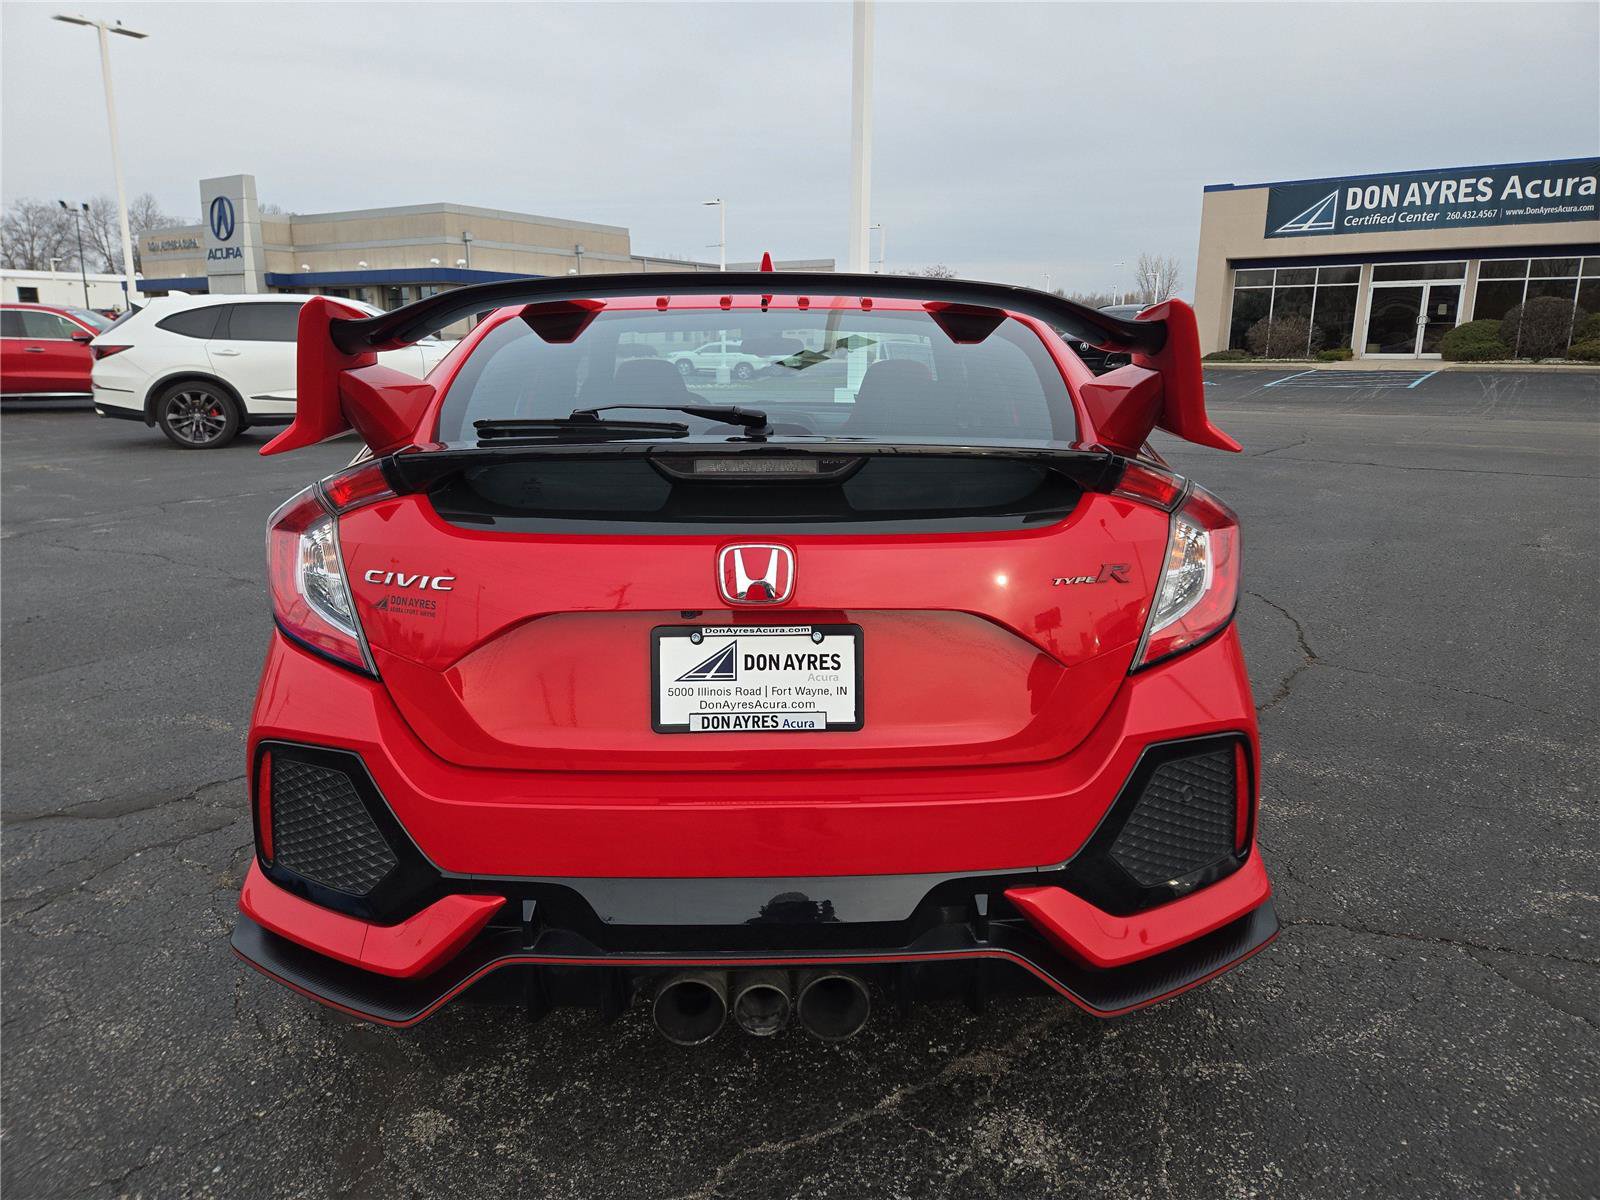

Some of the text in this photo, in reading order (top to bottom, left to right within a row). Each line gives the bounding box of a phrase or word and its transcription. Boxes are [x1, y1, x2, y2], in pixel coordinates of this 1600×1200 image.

[1345, 174, 1597, 211] DON AYRES Acura
[1344, 203, 1595, 227] Certified Center 260.432.4567 www.DonAyresAcura.com
[208, 247, 242, 260] ACURA
[364, 569, 456, 591] CIVIC
[1053, 563, 1131, 586] TYPE R
[391, 595, 436, 610] DON AYRES
[704, 626, 810, 635] DonAyresAcura.com
[744, 653, 842, 671] DON AYRES
[807, 673, 839, 682] Acura
[667, 686, 848, 697] 5000 Illinois Road Fort Wayne, IN
[699, 700, 816, 711] DonAyresAcura.com
[701, 715, 815, 729] DON AYRES Acura
